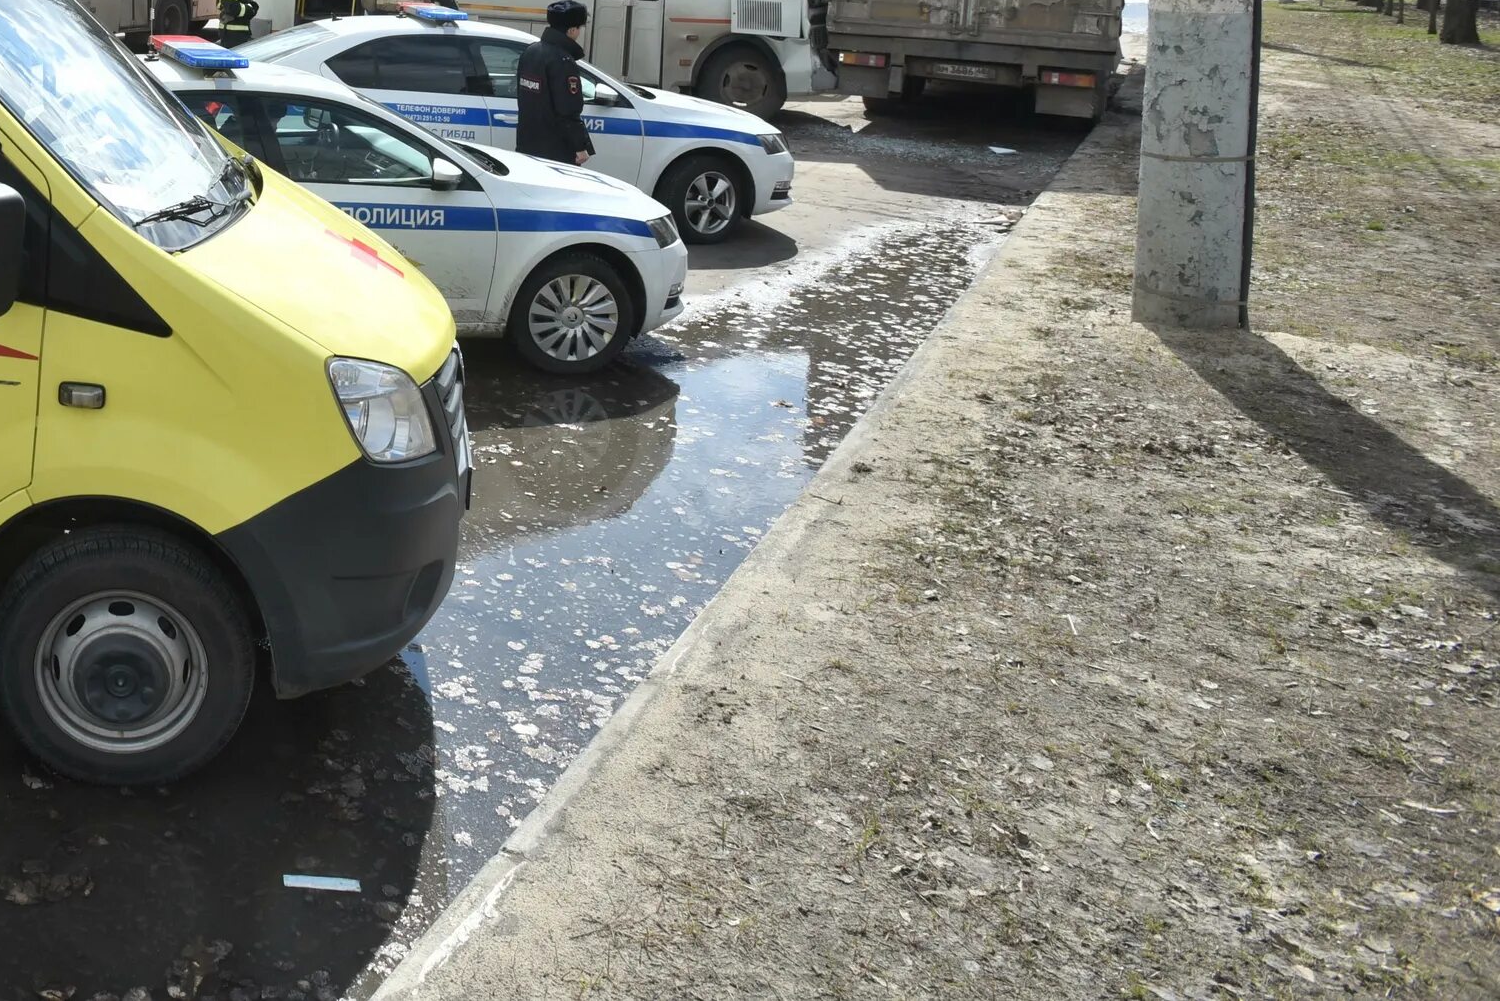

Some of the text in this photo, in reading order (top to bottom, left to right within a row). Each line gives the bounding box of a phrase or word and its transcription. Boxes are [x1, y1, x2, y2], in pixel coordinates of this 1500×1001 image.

[396, 104, 467, 115] ТЕЛЕФОН ДОВЕРИЯ
[441, 130, 476, 140] ГИБДД
[340, 207, 445, 229] ПОЛИЦИЯ
